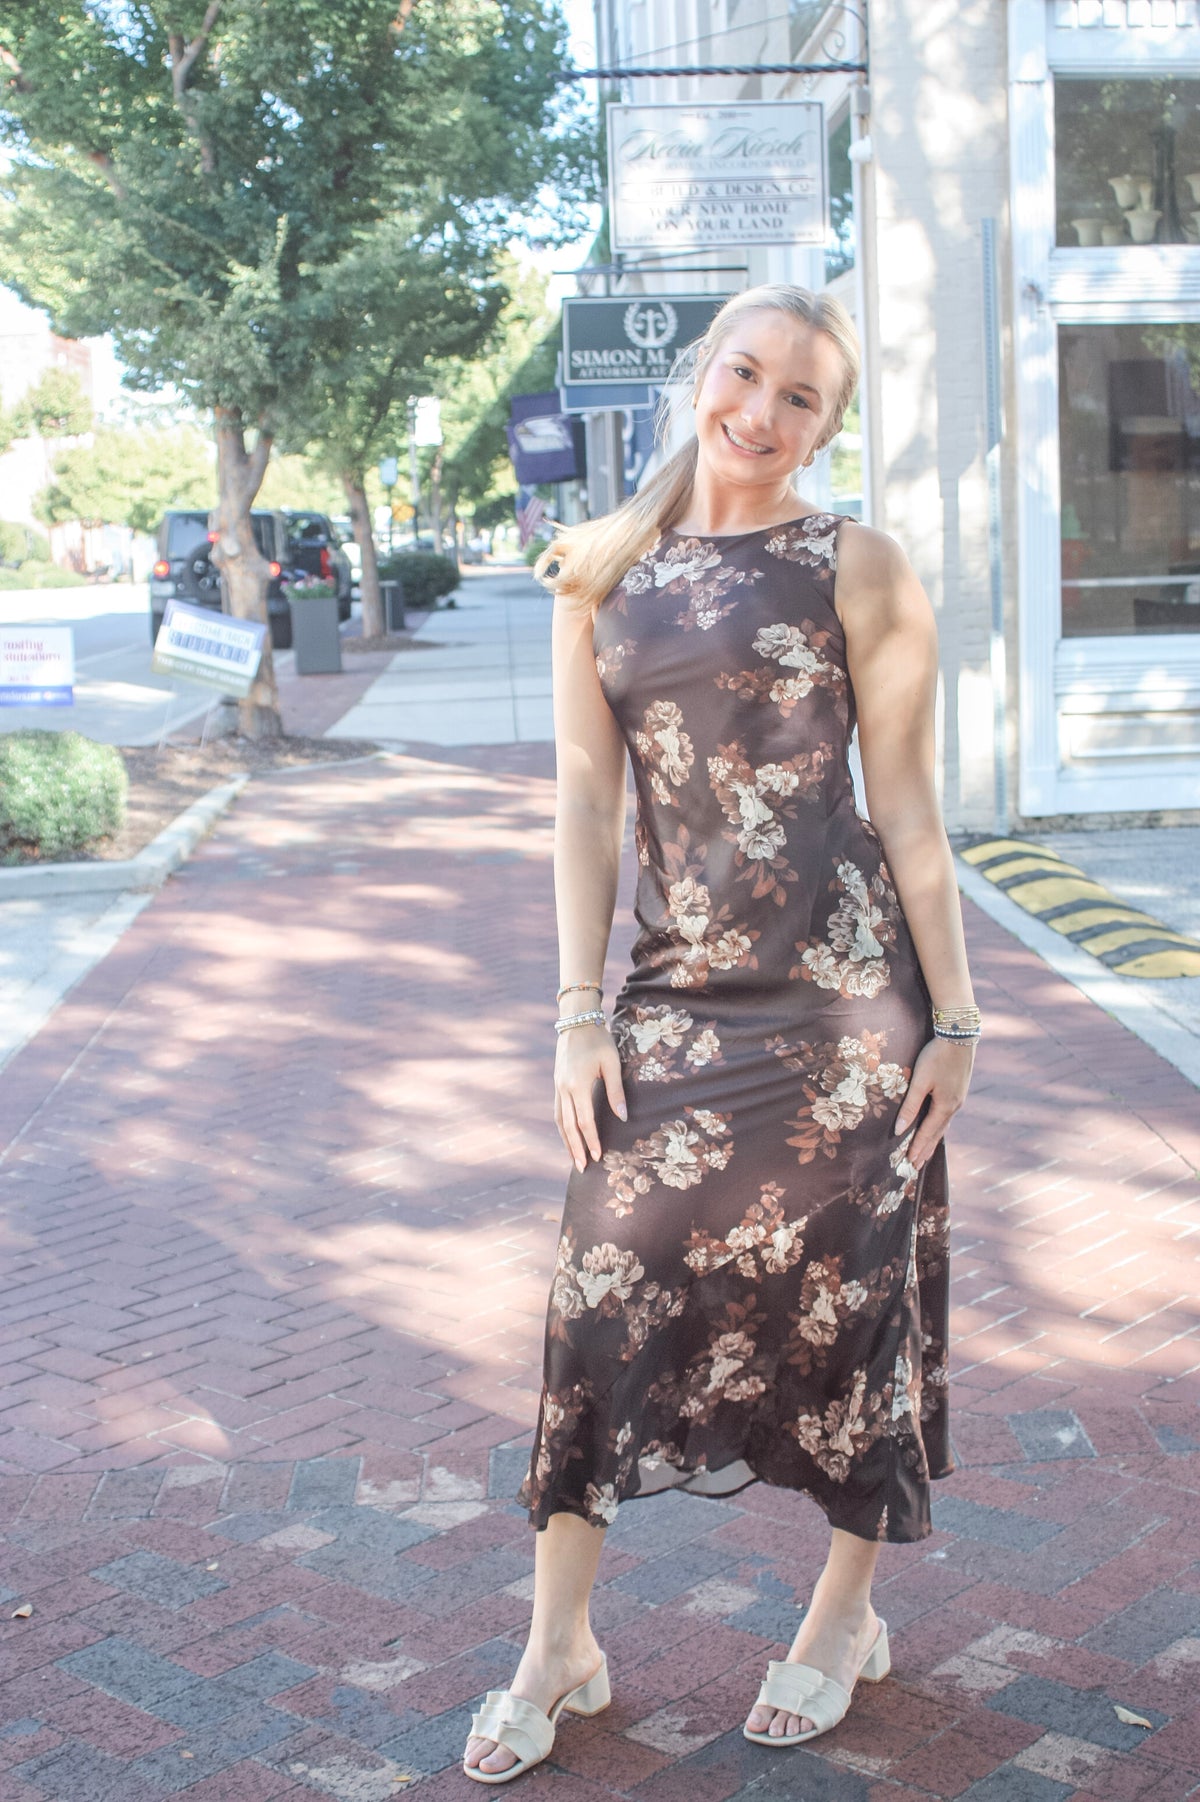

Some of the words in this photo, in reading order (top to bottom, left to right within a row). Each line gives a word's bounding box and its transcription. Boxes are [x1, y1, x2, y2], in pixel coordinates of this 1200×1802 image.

[705, 184, 717, 196] &
[725, 182, 781, 195] DESIGN
[650, 202, 691, 216] YOUR
[700, 201, 735, 215] NEW
[744, 200, 792, 214] HOME
[656, 219, 678, 231] ON
[688, 218, 731, 231] YOUR
[739, 217, 783, 230] LAND
[571, 350, 642, 368] SIMON
[647, 349, 671, 366] M.
[579, 366, 648, 378] ATTORNEY
[650, 366, 668, 376] AT
[169, 629, 250, 664] STUDENTS
